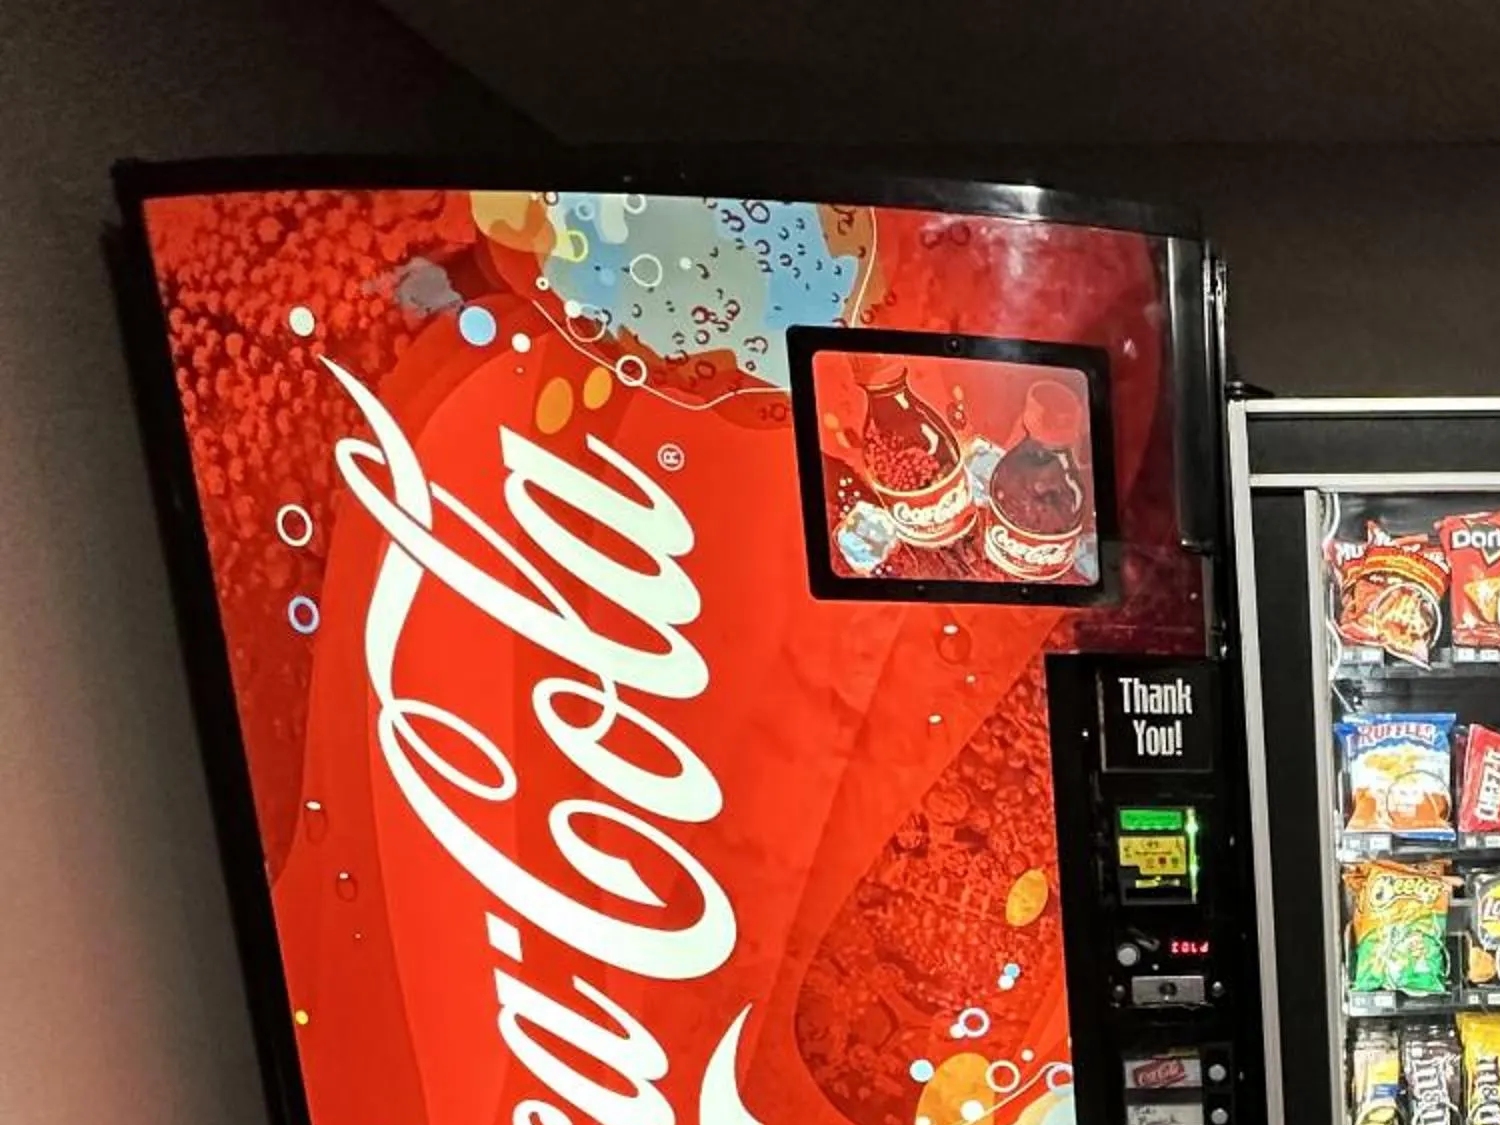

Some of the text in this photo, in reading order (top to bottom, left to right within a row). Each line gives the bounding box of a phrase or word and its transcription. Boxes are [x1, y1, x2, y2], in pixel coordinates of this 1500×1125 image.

[1118, 677, 1193, 715] Thank
[1132, 719, 1184, 756] You!
[1358, 721, 1437, 745] RUFFLES
[1372, 873, 1443, 908] Cheetos
